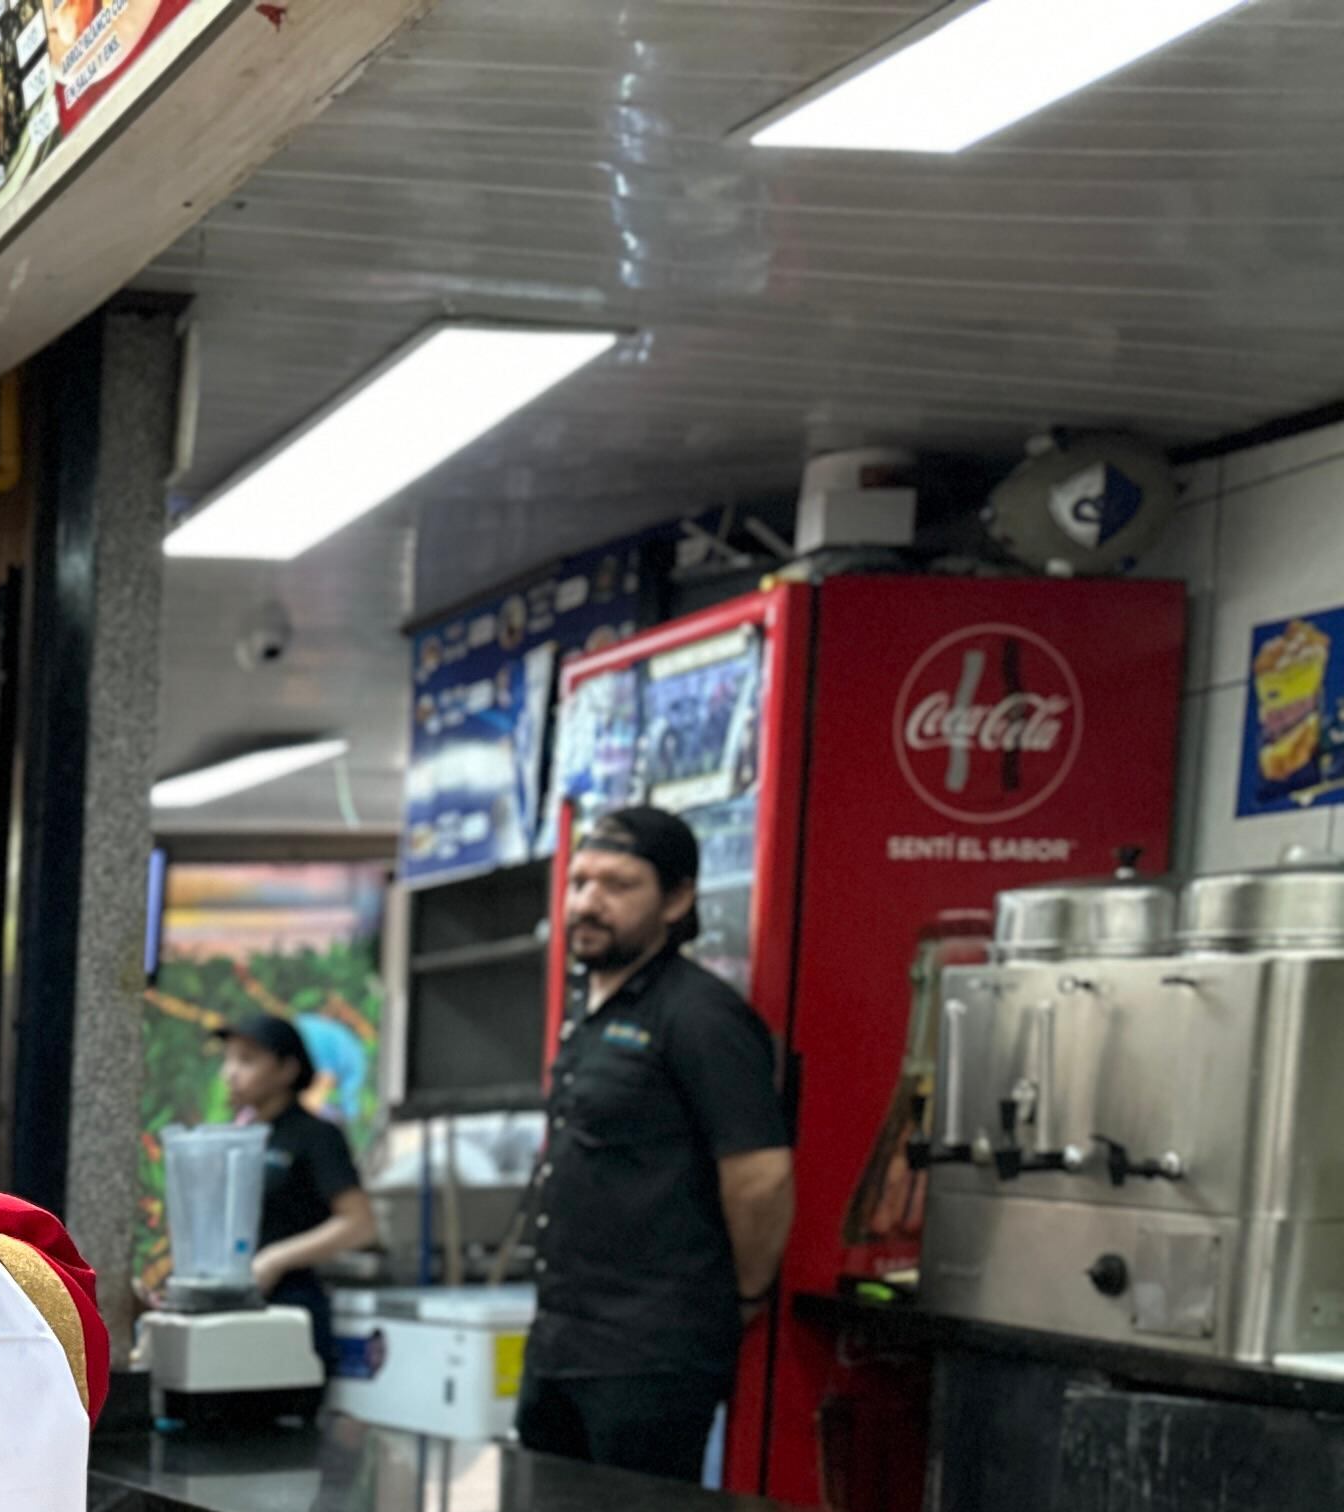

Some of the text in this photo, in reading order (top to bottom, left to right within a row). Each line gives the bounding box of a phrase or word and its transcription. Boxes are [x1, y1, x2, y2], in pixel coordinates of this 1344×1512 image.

[886, 833, 1069, 863] SENTÍ EL SABOR
